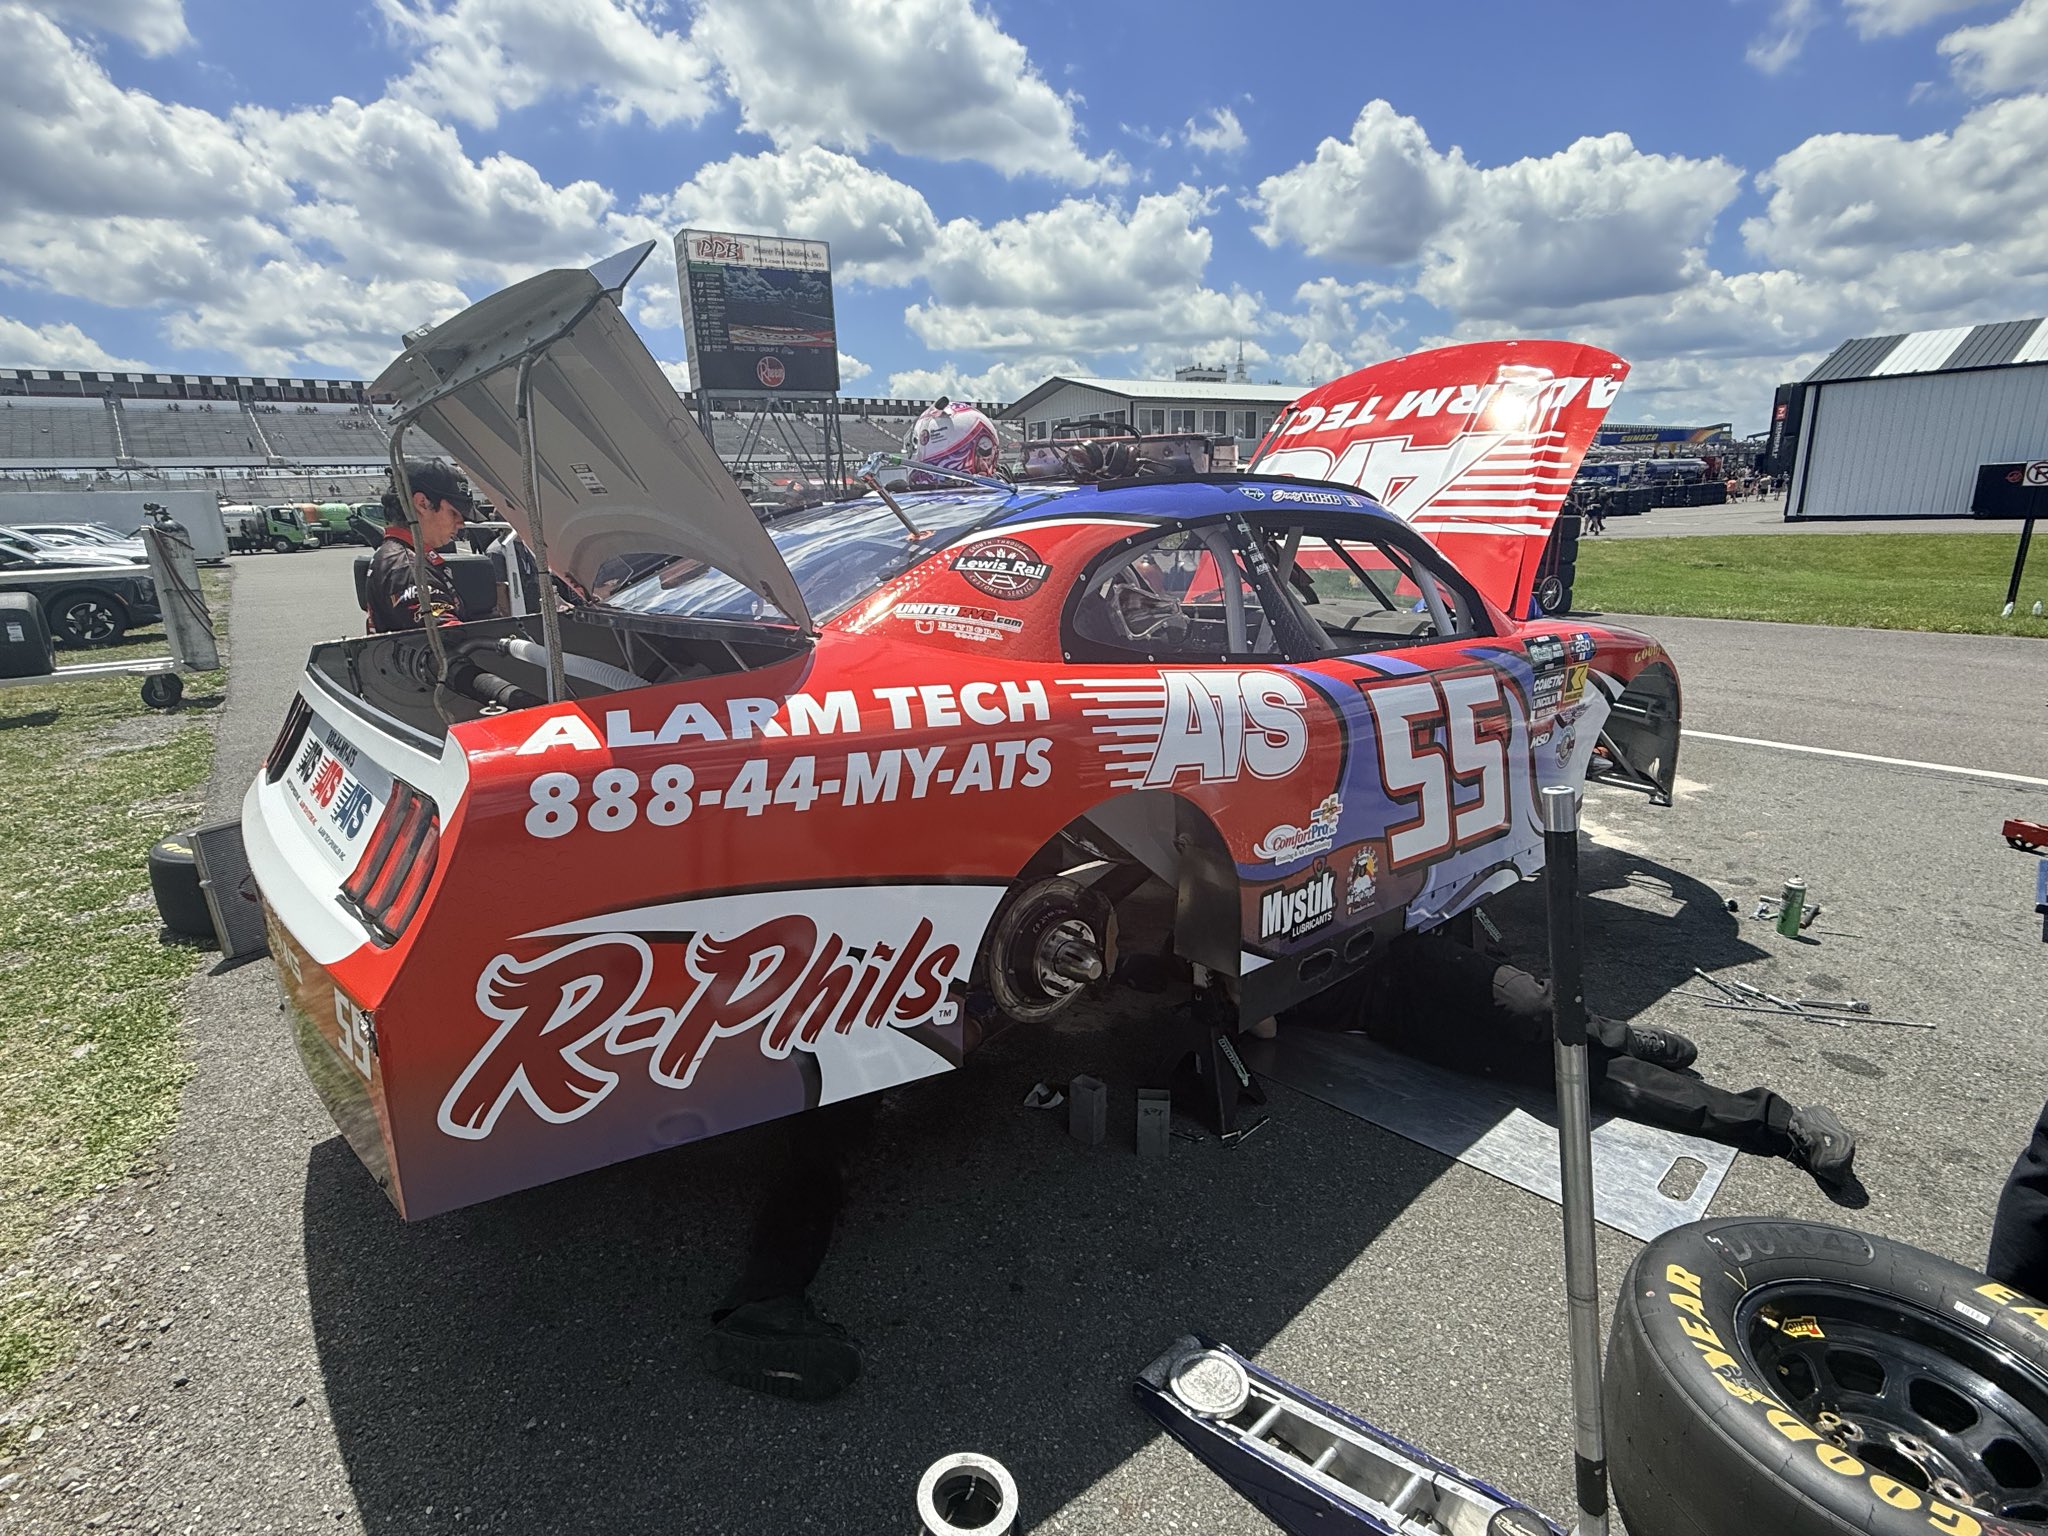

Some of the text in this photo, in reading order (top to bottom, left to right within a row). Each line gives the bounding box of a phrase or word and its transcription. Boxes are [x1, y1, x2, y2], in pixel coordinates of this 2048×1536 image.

[701, 239, 739, 258] PPB
[1387, 377, 1624, 421] ALRM
[1620, 433, 1659, 443] SUNOCO
[968, 540, 1028, 553] GROWTH THROUGH
[956, 557, 1047, 576] Lewis Rail
[969, 574, 1035, 596] CUSTOMER SERVICE
[1575, 640, 1591, 653] 250
[1534, 674, 1564, 692] COMETIC
[1533, 693, 1557, 710] LINCOLN
[516, 682, 1052, 756] ALARM TECH
[1139, 670, 1309, 791] ATS
[1530, 732, 1550, 749] MSD
[1362, 671, 1509, 867] 55
[311, 758, 344, 808] ATS
[523, 737, 1055, 839] 888-44-MY-ATS
[333, 782, 373, 840] ATS
[1262, 873, 1335, 938] Mystik
[1292, 911, 1332, 937] LUBRICANTS
[938, 1009, 953, 1019] TM
[334, 987, 372, 1081] 55
[437, 914, 962, 1140] R-Phils
[1787, 1321, 1814, 1333] AERO
